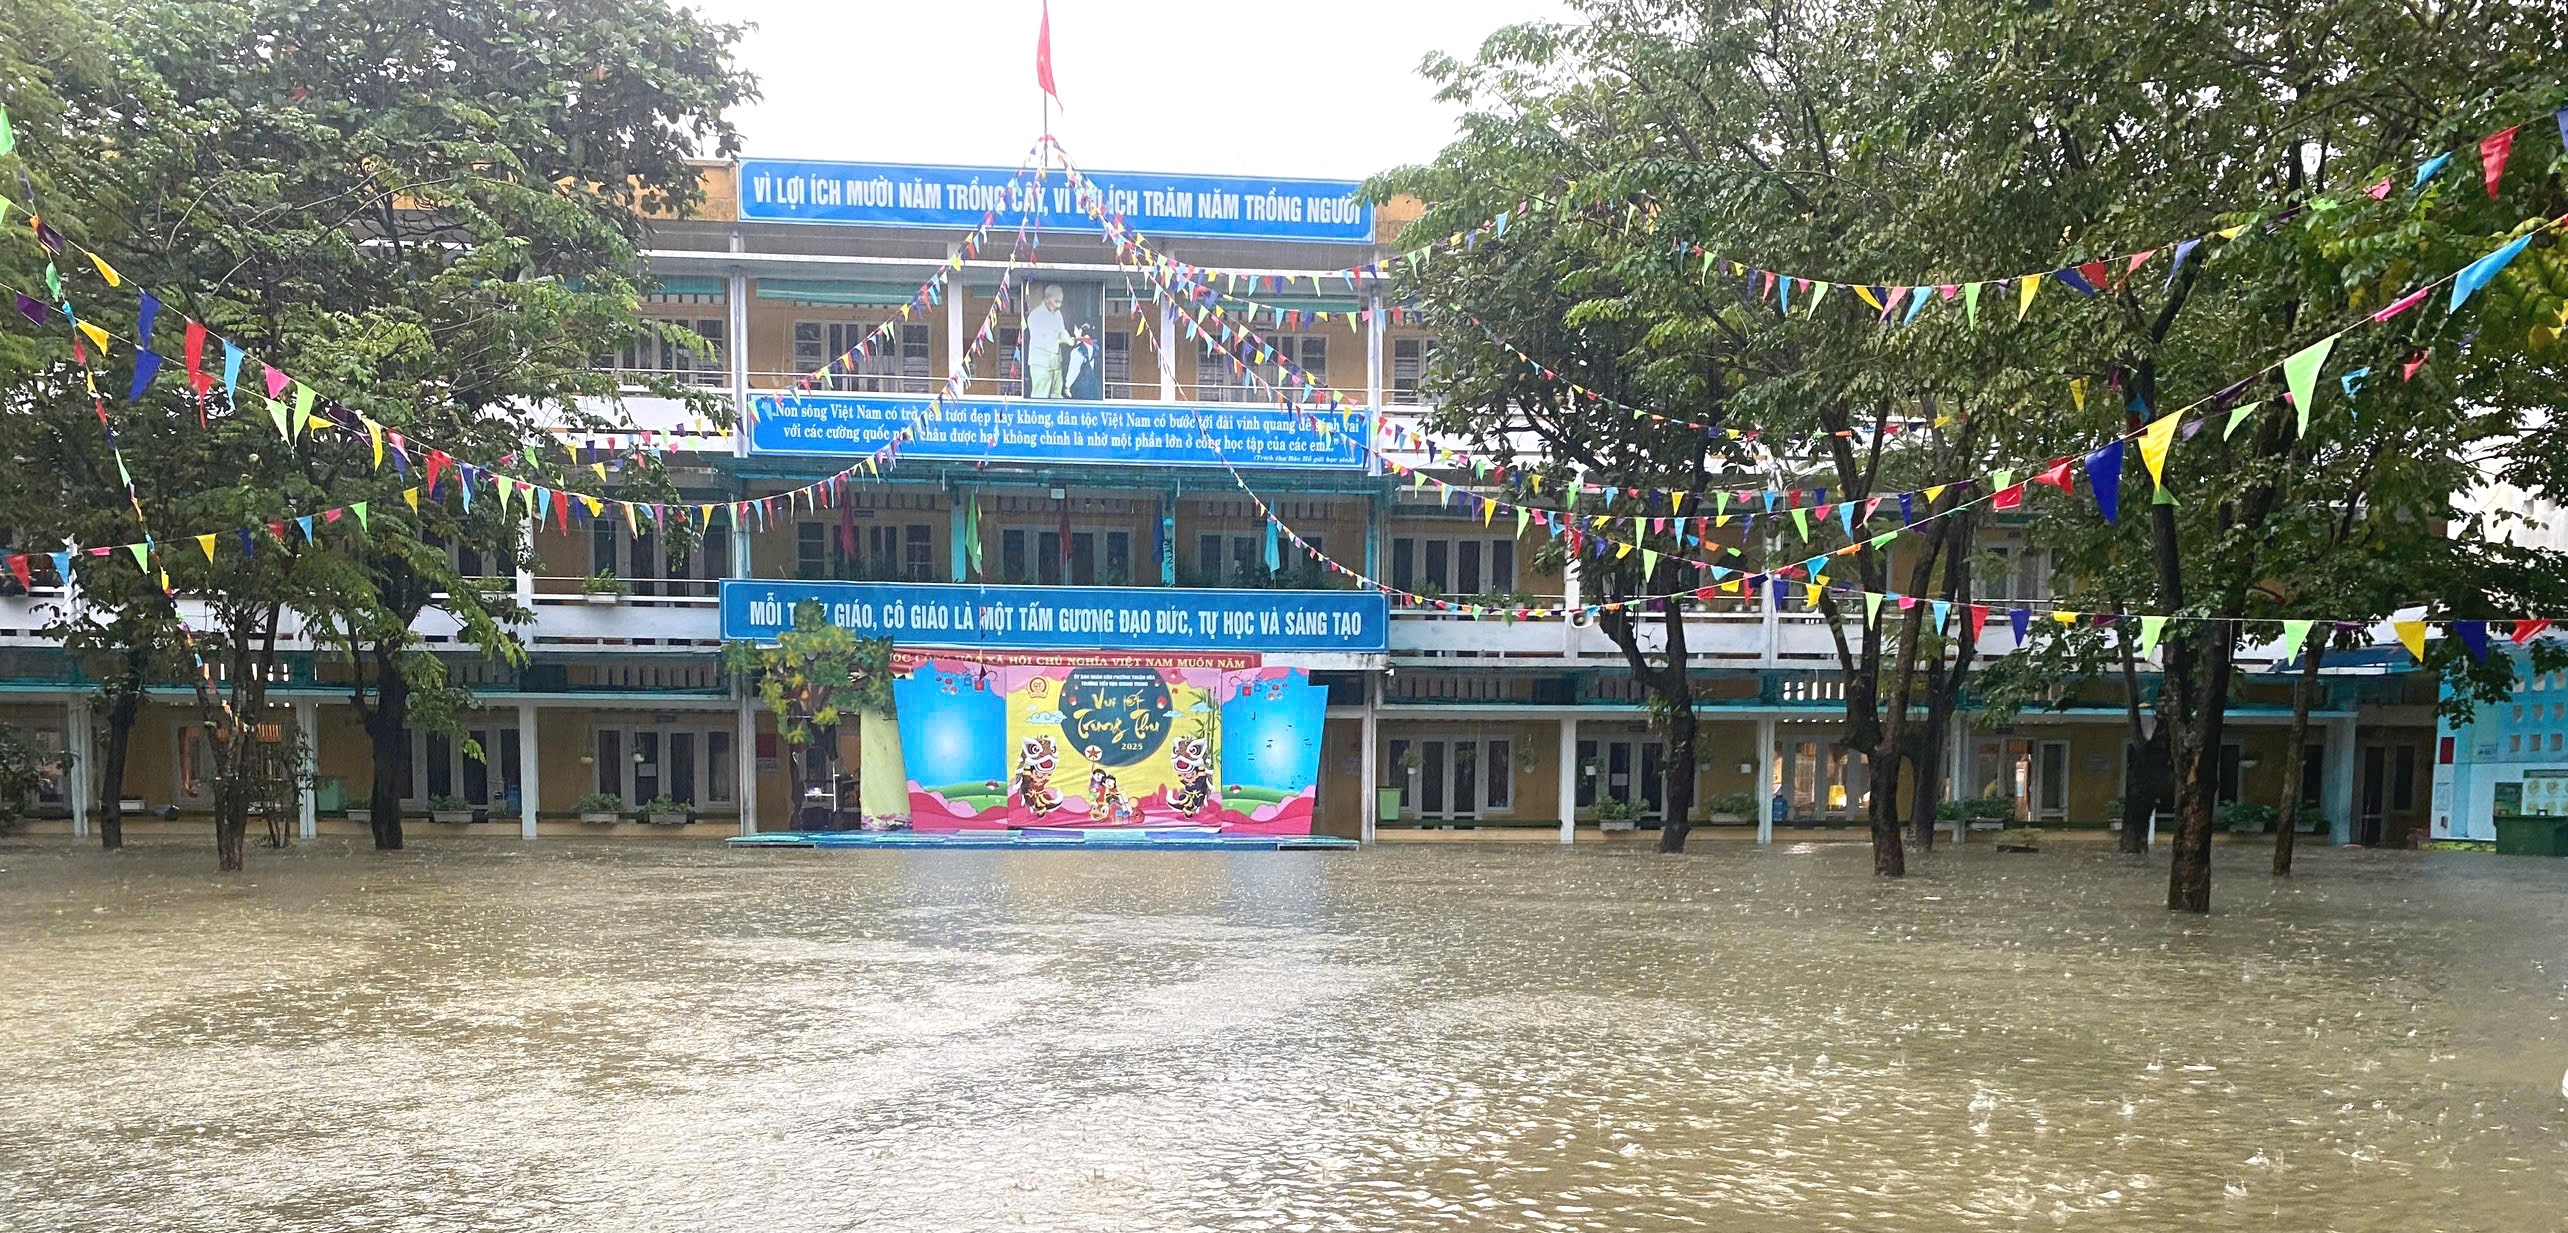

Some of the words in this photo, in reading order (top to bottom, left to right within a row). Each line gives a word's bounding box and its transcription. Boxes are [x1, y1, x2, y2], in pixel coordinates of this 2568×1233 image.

[753, 171, 771, 203] VÌ
[776, 175, 805, 210] LỢI
[810, 173, 841, 206] ÍCH
[846, 175, 894, 208] MƯỜI
[899, 177, 941, 209] NĂM
[1053, 182, 1071, 214] VÌ
[1108, 183, 1138, 215] ÍCH
[1143, 186, 1193, 218] TRĂM
[1198, 187, 1240, 220] NĂM
[1244, 187, 1302, 223] TRỒNG
[1306, 191, 1361, 225] NGƯỜI
[801, 405, 828, 421] sông
[830, 403, 854, 421] Việt
[856, 404, 882, 420] Nam
[885, 405, 898, 420] có
[901, 406, 919, 421] trở
[945, 407, 967, 422] tươi
[970, 408, 991, 426] đẹp
[994, 409, 1014, 427] hay
[1016, 409, 1054, 428] không,
[1057, 410, 1078, 425] dân
[1080, 411, 1098, 429] tộc
[1100, 411, 1123, 429] Việt
[1126, 412, 1151, 428] Nam
[1153, 412, 1166, 428] có
[1169, 413, 1196, 429] bước
[1216, 414, 1233, 430] đài
[1236, 415, 1260, 431] vinh
[1263, 420, 1296, 435] quang
[1342, 418, 1359, 433] vai
[783, 423, 801, 438] với
[804, 424, 823, 438] các
[826, 425, 860, 442] cường
[863, 423, 890, 443] quốc
[919, 427, 947, 442] châu
[950, 428, 977, 445] được
[1002, 429, 1039, 448] không
[1039, 429, 1070, 446] chính
[1073, 432, 1084, 446] là
[1087, 432, 1108, 447] nhờ
[1111, 433, 1132, 449] một
[1135, 430, 1163, 450] phần
[1165, 433, 1183, 448] lớn
[1185, 434, 1193, 448] ở
[1195, 434, 1221, 450] công
[1224, 435, 1244, 453] học
[1246, 435, 1264, 455] tập
[1266, 436, 1286, 452] của
[1288, 437, 1307, 452] các
[750, 592, 782, 626] MỖI
[834, 598, 878, 631] GIÁO,
[883, 599, 905, 629] CÔ
[910, 600, 948, 630] GIÁO
[954, 600, 974, 630] LÀ
[979, 601, 1014, 636] MỘT
[1018, 601, 1053, 632] TẤM
[1058, 608, 1114, 633] GƯƠNG
[1119, 609, 1151, 639] ĐẠO
[1155, 605, 1193, 638] ĐỨC,
[1198, 610, 1219, 640] TỰ
[1223, 611, 1255, 640] HỌC
[1259, 606, 1280, 635] VÀ
[1284, 606, 1328, 636] SÁNG
[1332, 611, 1362, 641] TẠO
[1009, 655, 1033, 666] HỘI
[1036, 654, 1063, 666] CHỦ
[1067, 657, 1108, 666] NGHĨA
[1111, 656, 1142, 668] VIỆT
[1145, 658, 1173, 667] NAM
[1177, 657, 1213, 668] MUÔN
[1217, 657, 1245, 668] NĂM
[1091, 687, 1117, 710] Vui
[1073, 708, 1130, 744] Trung
[1130, 708, 1160, 740] Thu
